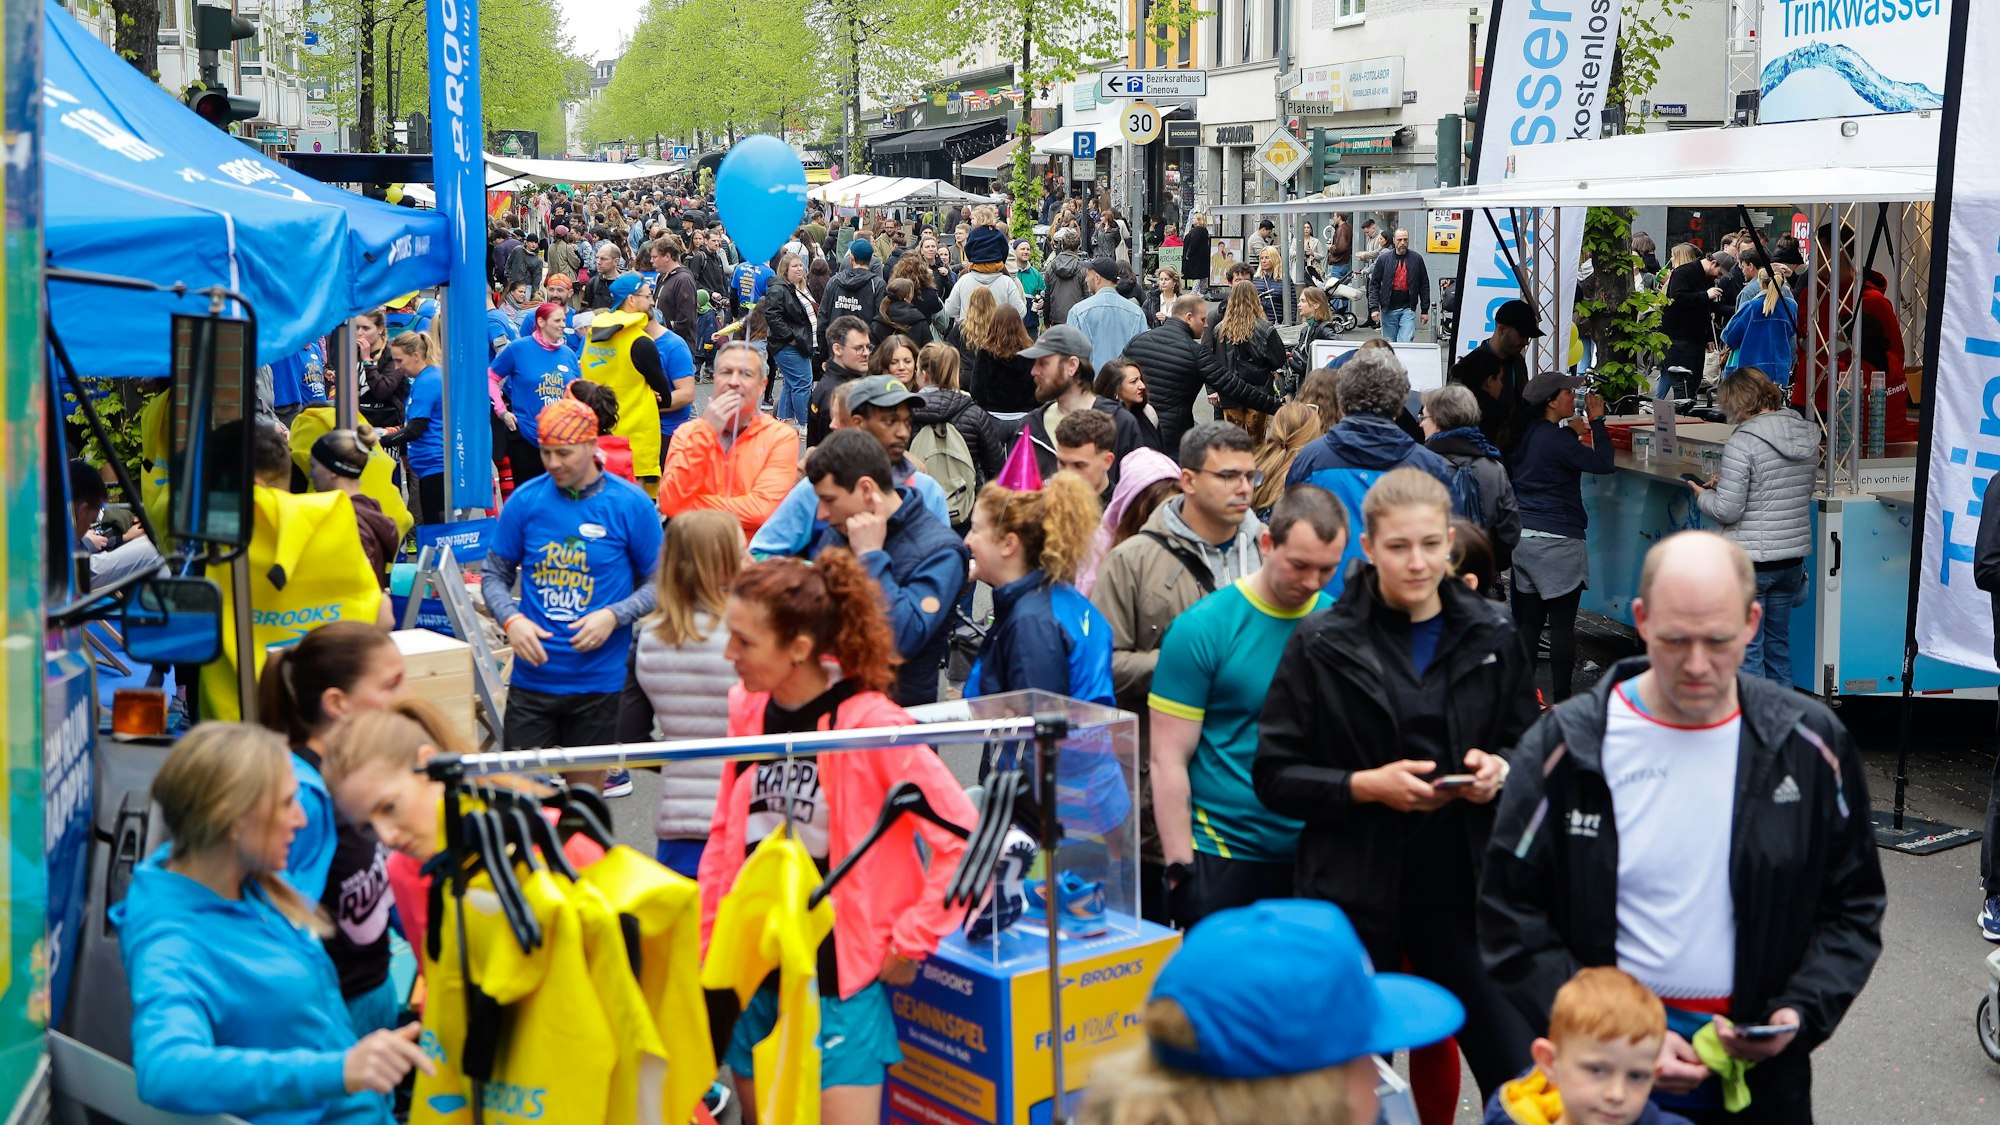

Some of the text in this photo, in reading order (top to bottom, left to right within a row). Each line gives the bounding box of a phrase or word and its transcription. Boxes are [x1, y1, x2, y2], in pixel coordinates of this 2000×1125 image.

[1146, 73, 1200, 83] Bezirksrathaus
[1349, 69, 1390, 83] ARIAN-FOTOLABOR
[1566, 0, 1611, 140] kostenlos
[1146, 85, 1179, 94] Cinenova
[1287, 102, 1332, 114] Platenstr.
[1129, 114, 1152, 132] 30
[834, 300, 862, 311] Energie
[838, 295, 859, 306] Rhein
[541, 372, 566, 388] Run
[1874, 476, 1890, 484] von
[1892, 474, 1910, 484] hier.
[538, 541, 591, 573] Run
[531, 559, 595, 606] Happy
[537, 587, 588, 612] Tour
[250, 603, 342, 627] BROOKS
[923, 963, 975, 996] BROOKS
[1079, 958, 1145, 988] BROOKS
[893, 991, 988, 1054] GEWINNSPIEL
[1034, 1010, 1146, 1052] Fid YOUR ru
